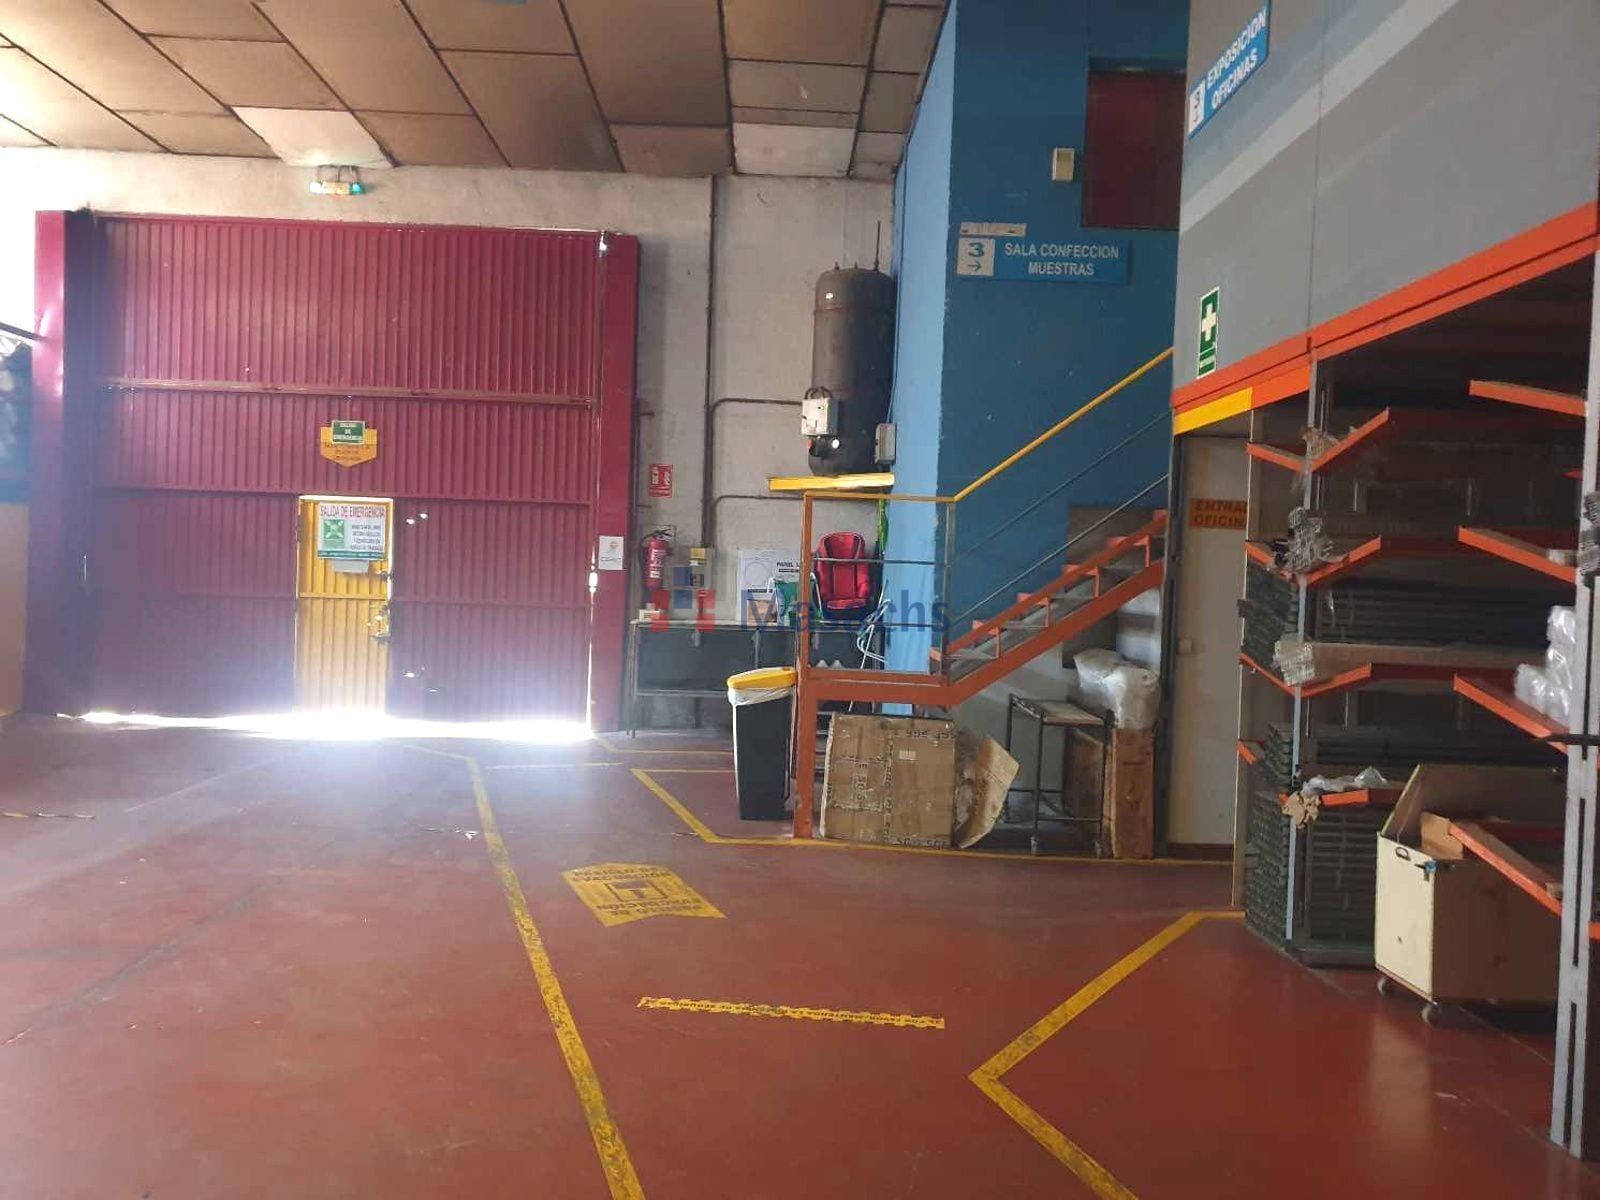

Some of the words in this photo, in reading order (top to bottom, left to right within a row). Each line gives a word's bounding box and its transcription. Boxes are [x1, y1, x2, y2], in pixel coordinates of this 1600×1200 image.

[1206, 6, 1266, 90] EXPOSICION
[1211, 47, 1258, 109] OFICINAS
[967, 242, 985, 258] 3
[1004, 242, 1037, 256] SALA
[1039, 243, 1120, 259] CONFECCION
[1027, 261, 1095, 276] MUESTRAS
[1194, 514, 1248, 527] OFICIN
